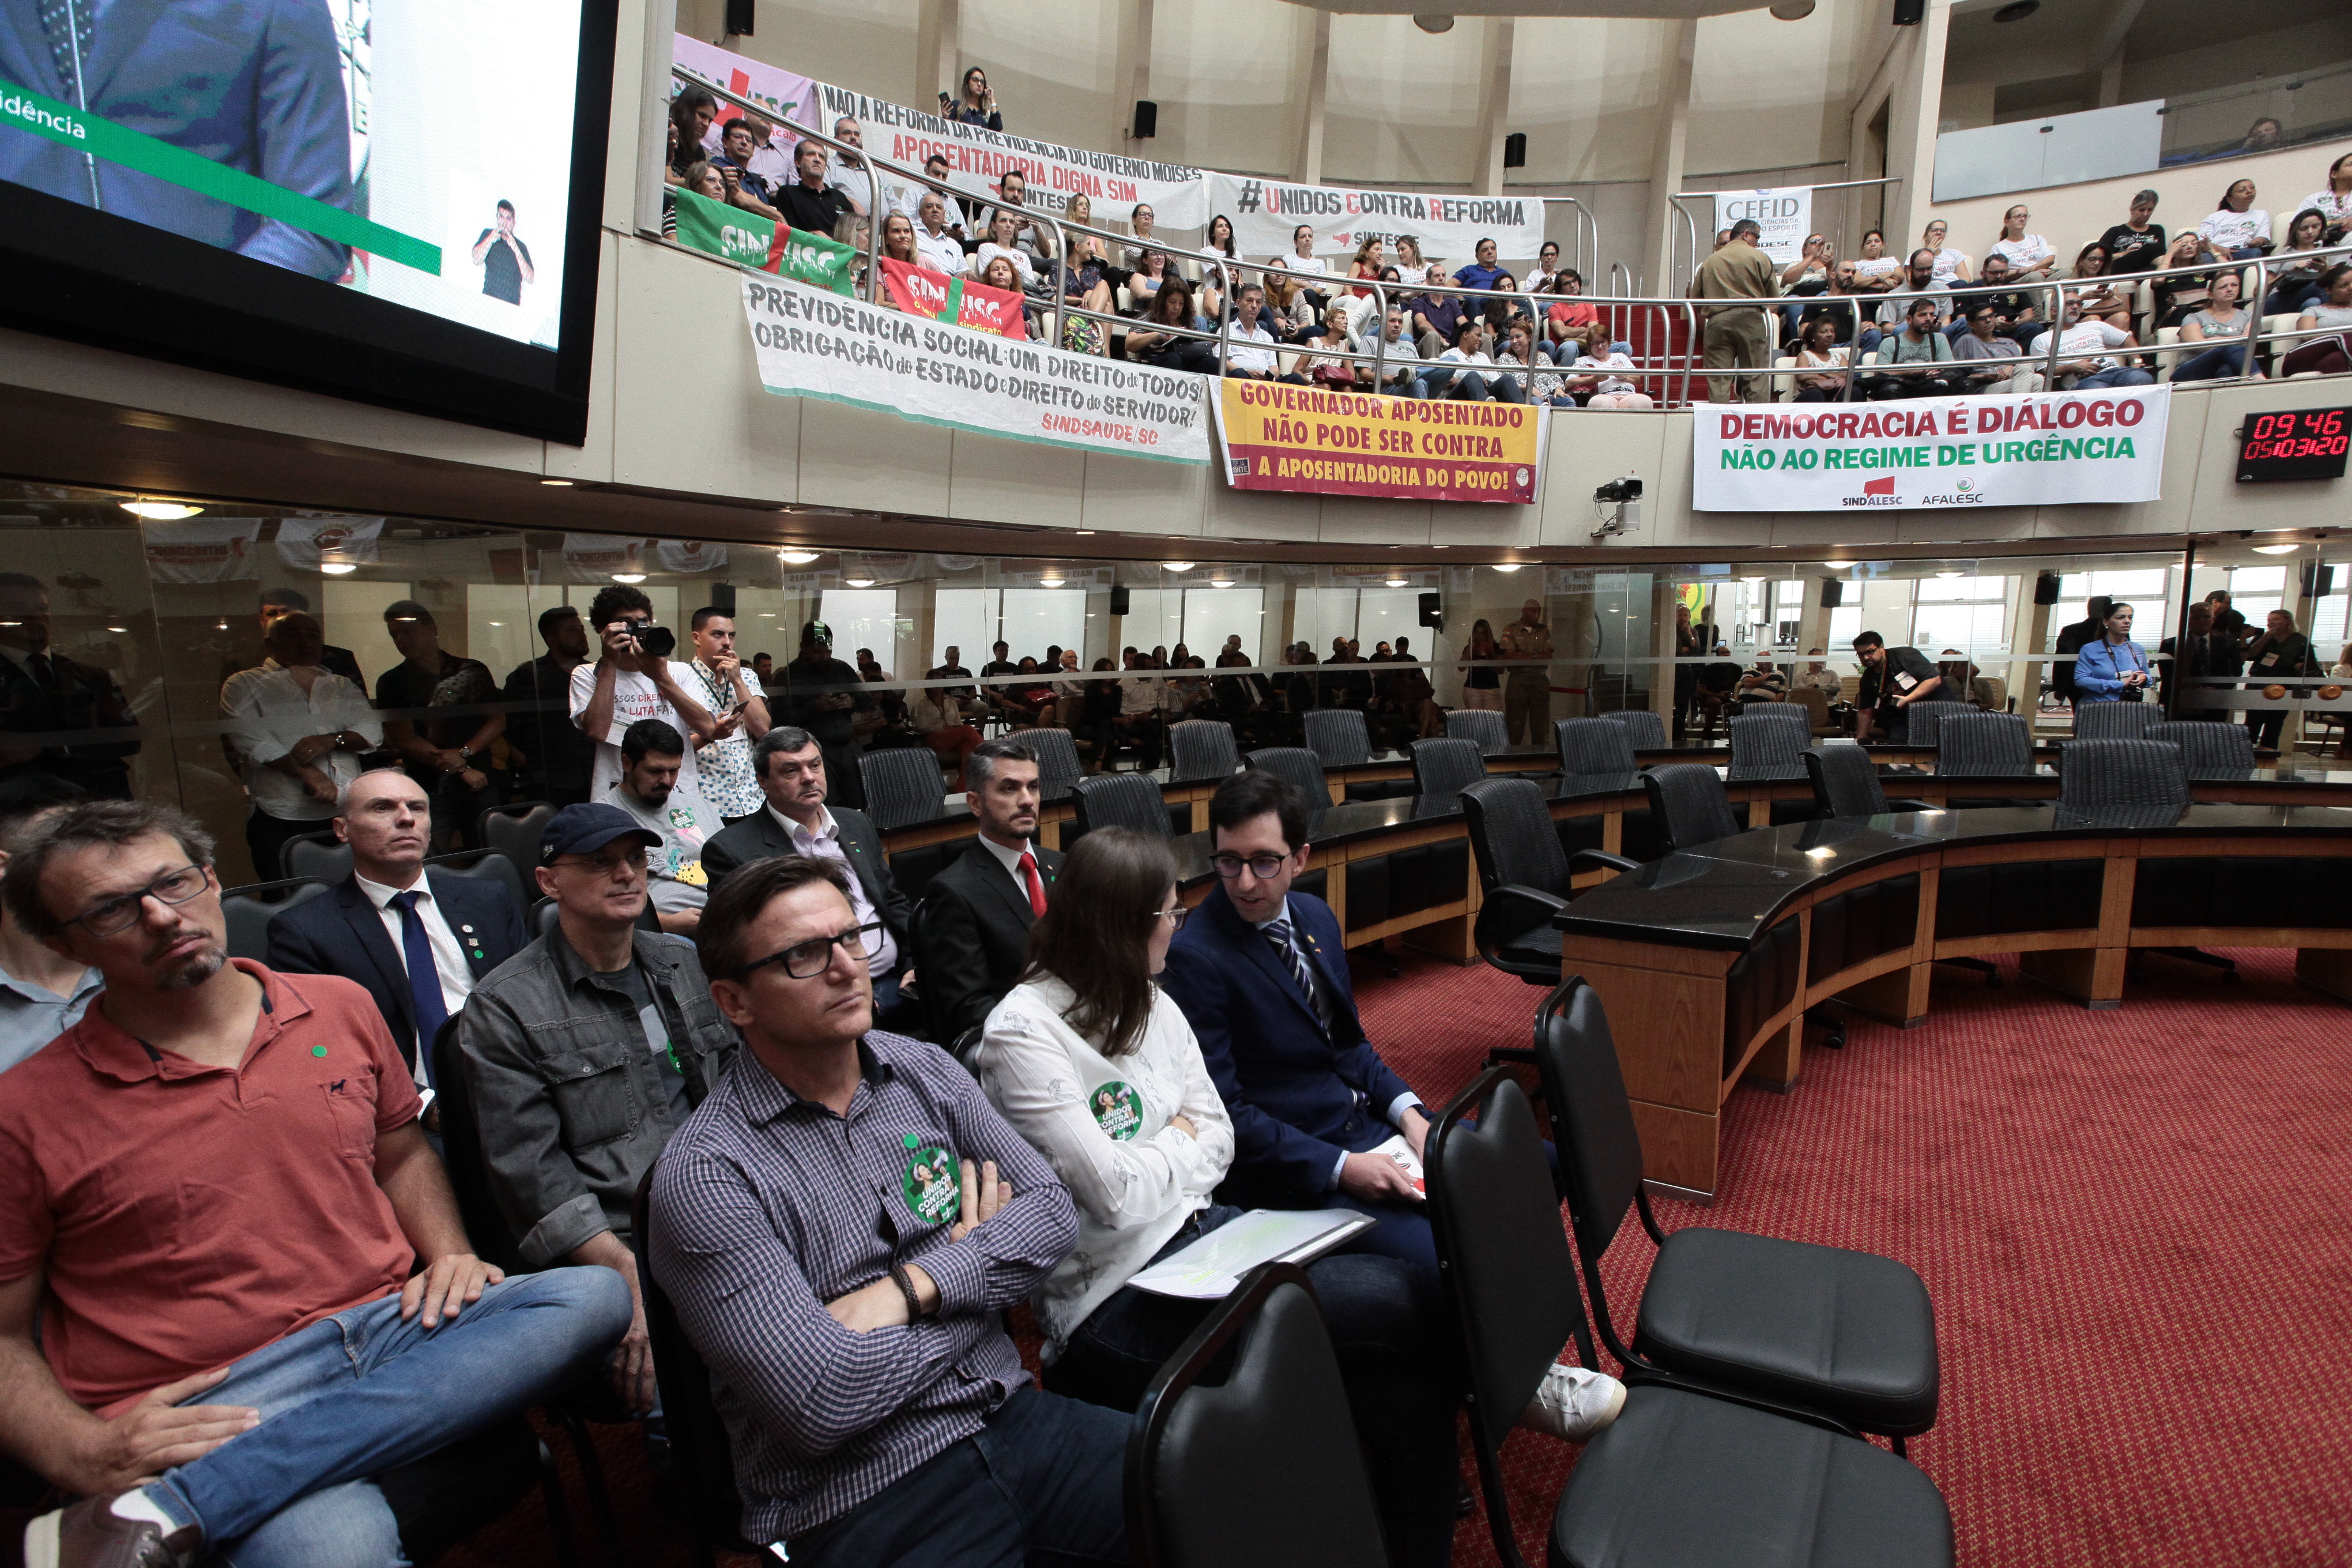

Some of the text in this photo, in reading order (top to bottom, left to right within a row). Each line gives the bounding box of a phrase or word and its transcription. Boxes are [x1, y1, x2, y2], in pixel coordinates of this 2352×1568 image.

[873, 99, 950, 136] REFORMA
[951, 120, 973, 140] DA
[1068, 148, 1087, 166] DO
[1090, 151, 1150, 180] GOVERNO
[893, 133, 1138, 203] APOSENTADORIA DIGNA SIM
[1238, 180, 1525, 227] #UNIDOS CONTRA REFORMA
[1726, 198, 1799, 220] CEFID
[922, 307, 936, 319] seu
[959, 320, 1002, 336] sindicato
[749, 282, 918, 348] PREVIDÊNCIA
[1047, 355, 1125, 389] DIREITO
[1126, 372, 1139, 388] de
[1139, 372, 1203, 403] TODOS!
[755, 321, 1196, 428] OBRIGAÇÃO do ESTADO e DIREITO do SERVIDOR!
[1241, 382, 1523, 428] GOVERNADOR APOSENTADO
[1721, 397, 2145, 439] DEMOCRACIA É DIÁLOGO
[1263, 413, 1503, 458] NÃO PODE SER CONTRA
[2253, 410, 2345, 440] 09 46
[1720, 433, 2136, 470] NÃO AO REGIME DE URGÊNCIA
[1258, 456, 1509, 490] A APOSENTADORIA DO POVO!
[1842, 496, 1903, 507] SINDALESC
[1922, 493, 1984, 505] AFALESC
[615, 694, 635, 703] SSOS
[629, 706, 655, 717] LUTA
[656, 704, 674, 716] FAZ
[1102, 1103, 1132, 1121] UNIDOS
[1103, 1115, 1140, 1134] REFORMA
[918, 1184, 950, 1212] CONTRA
[922, 1172, 951, 1198] UNIDOS
[925, 1185, 959, 1219] REFORMA
